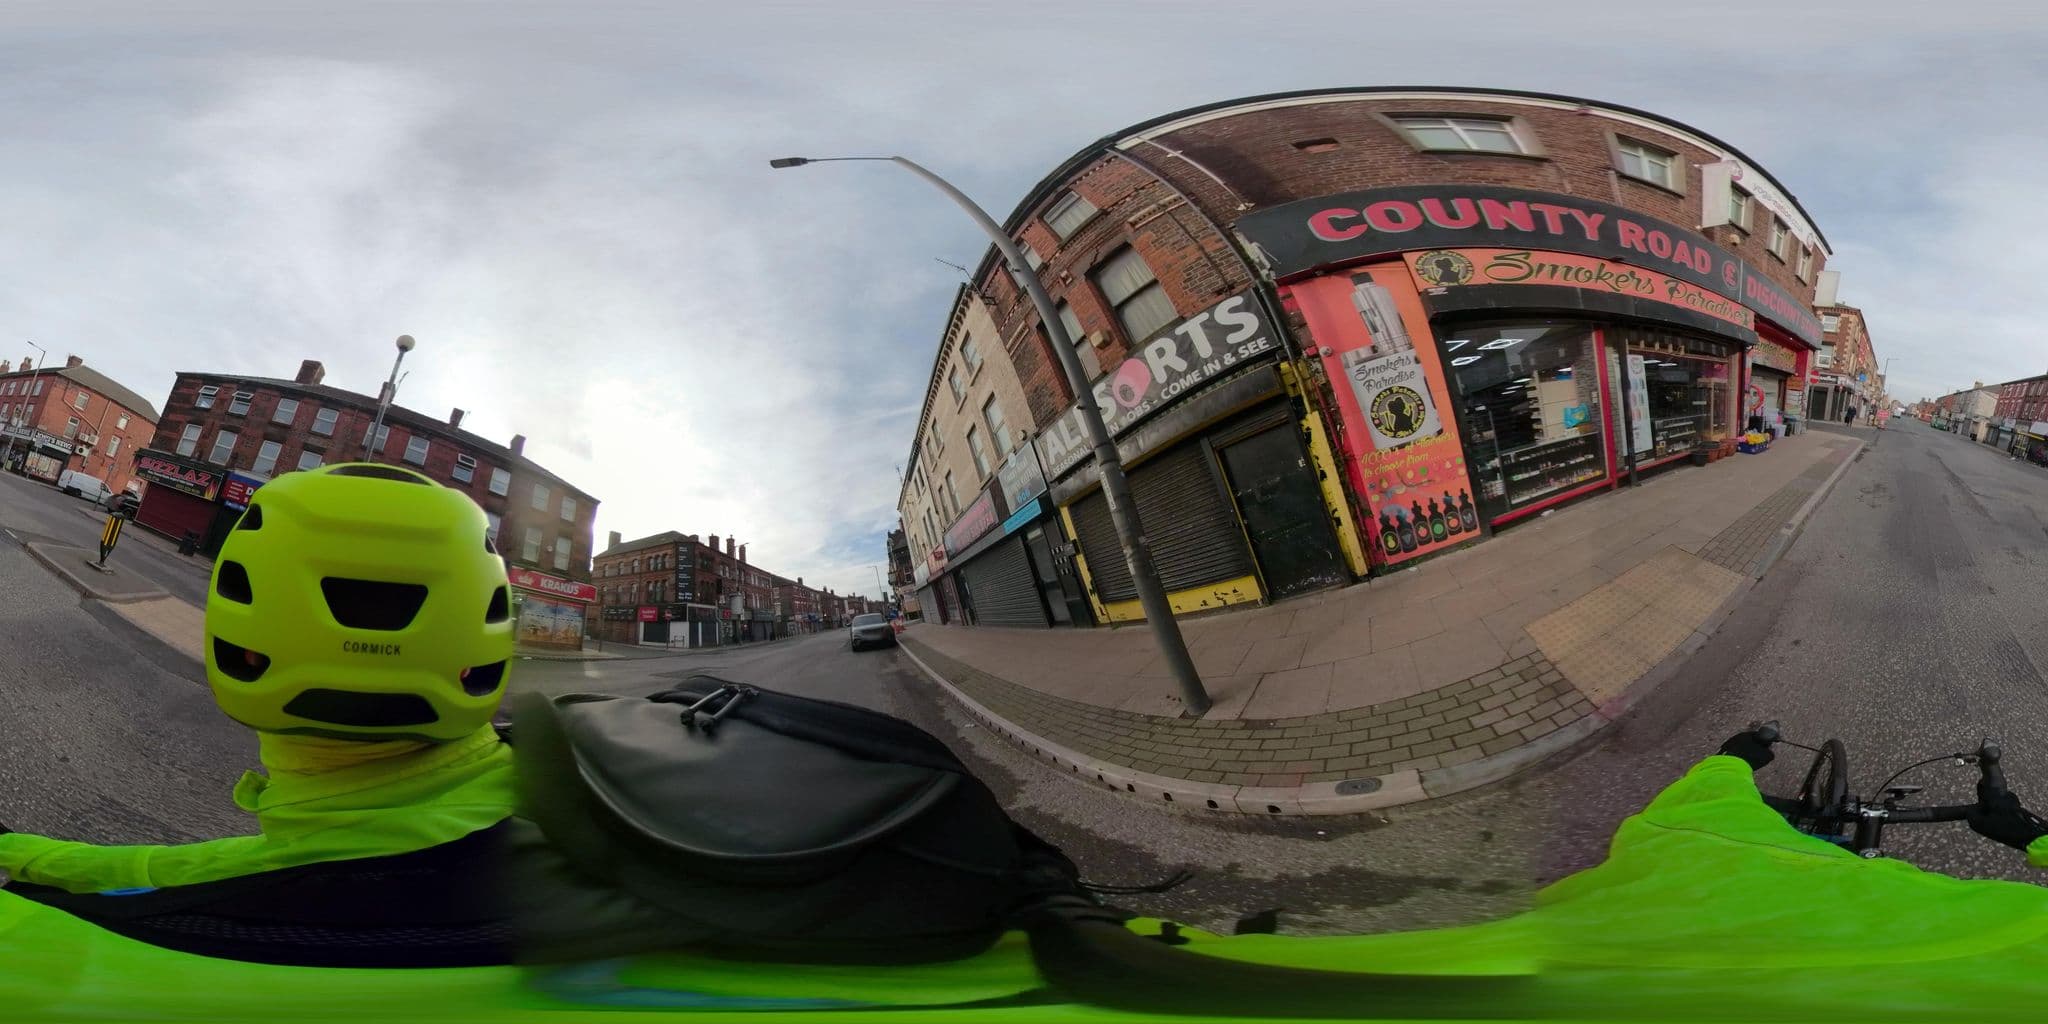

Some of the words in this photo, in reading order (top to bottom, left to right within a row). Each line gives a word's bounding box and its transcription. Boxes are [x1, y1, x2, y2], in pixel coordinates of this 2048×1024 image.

[1307, 197, 1605, 242] COUNTY
[1617, 219, 1712, 275] ROAD
[1484, 251, 1655, 295] Smokers
[1160, 371, 1203, 401] COME
[1203, 359, 1223, 378] IN
[1223, 351, 1237, 367] &
[1239, 336, 1271, 360] SEE
[1354, 355, 1412, 382] Smokers
[1363, 369, 1416, 394] Paradise
[539, 577, 580, 596] KRAKUS
[343, 640, 402, 656] CORMICK
